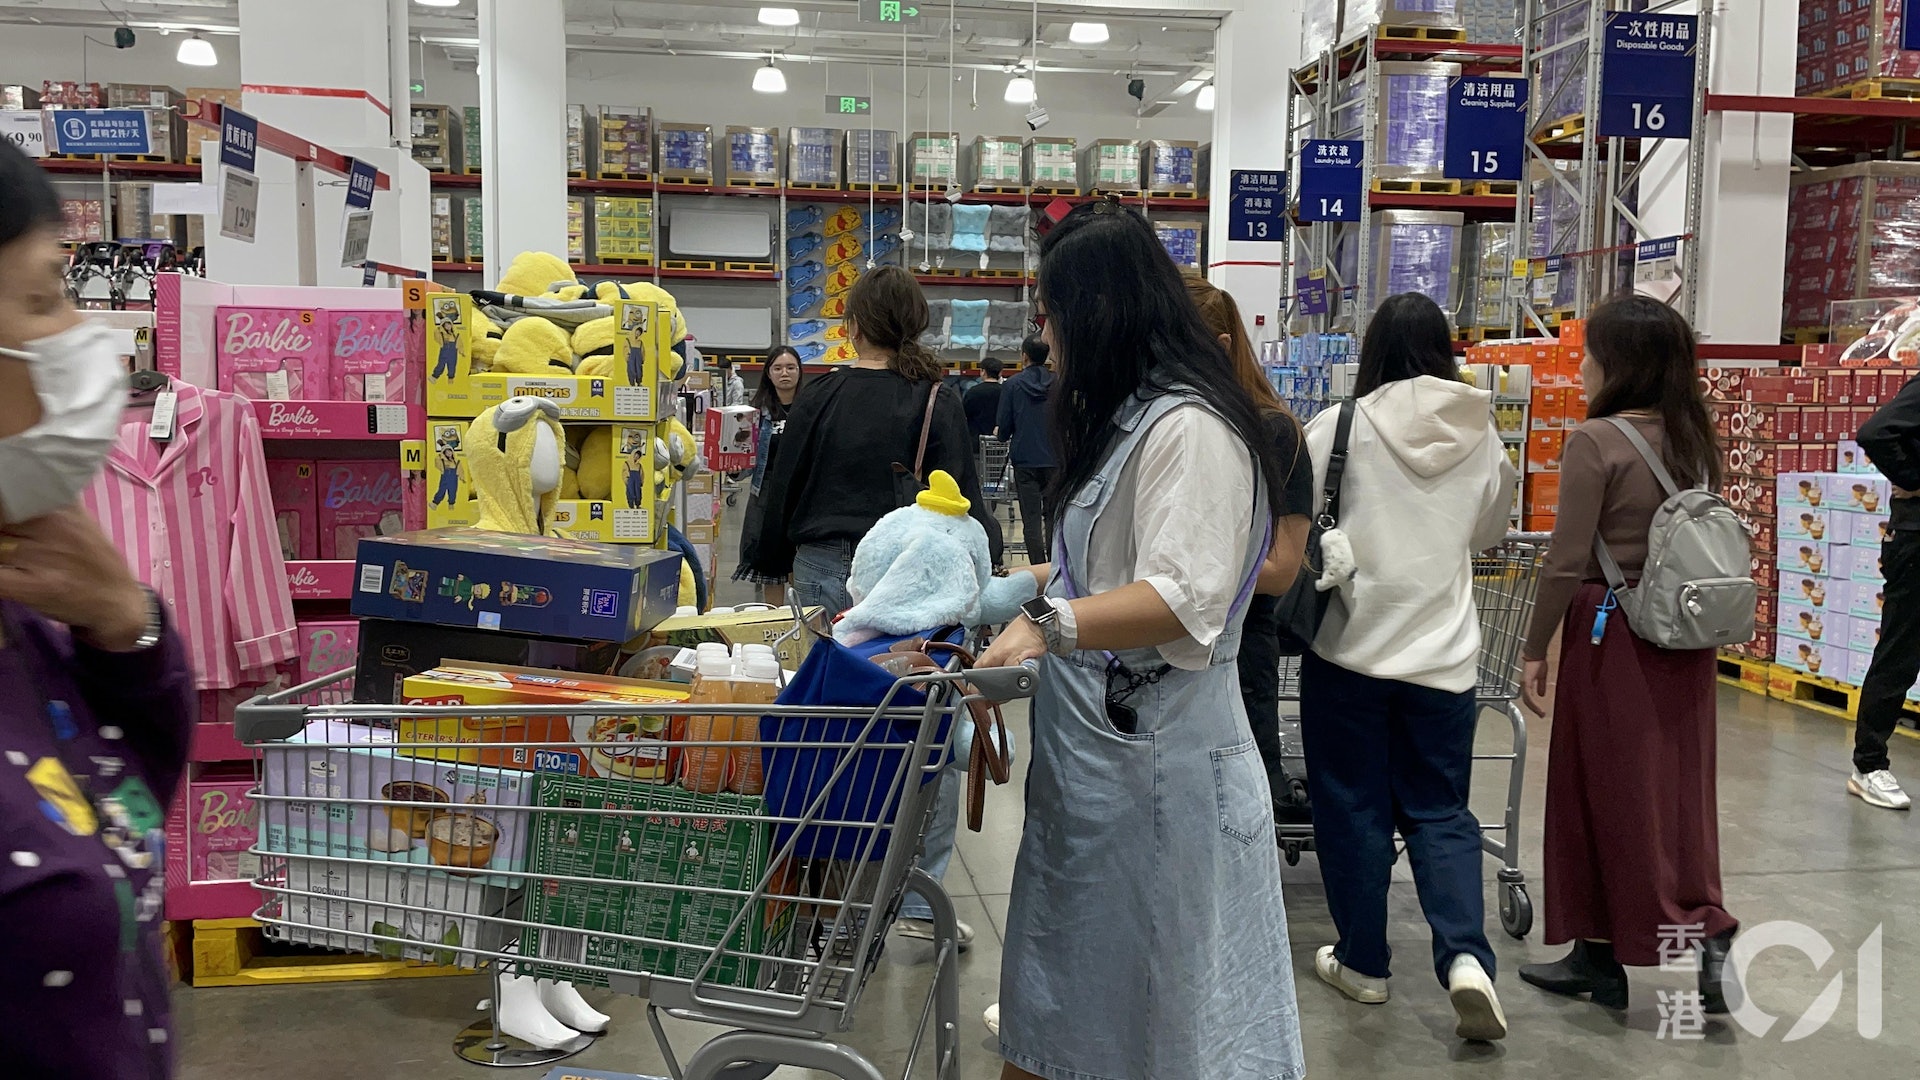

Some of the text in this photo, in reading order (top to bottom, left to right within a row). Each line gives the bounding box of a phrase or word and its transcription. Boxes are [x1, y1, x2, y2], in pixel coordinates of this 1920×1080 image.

[1614, 20, 1689, 39] 一次性用品
[1616, 40, 1685, 51] Disposable Goods
[1463, 82, 1515, 98] 清洁用品
[1460, 98, 1516, 108] Cleaning Supplies
[1632, 103, 1665, 130] 16
[1317, 145, 1349, 157] 洗衣液
[1314, 157, 1335, 165] Laundry
[1471, 150, 1498, 173] 15
[1240, 174, 1278, 185] 清洁用品
[1244, 198, 1272, 208] 消毒液
[1320, 199, 1343, 217] 14
[1247, 222, 1268, 237] 13
[409, 288, 420, 301] S
[303, 313, 311, 322] S
[136, 331, 147, 341] M
[224, 312, 312, 354] Barbie
[269, 402, 319, 426] Barbie
[406, 449, 421, 462] M
[299, 466, 309, 476] M
[405, 731, 453, 743] CTERR'S
[536, 753, 561, 770] 120
